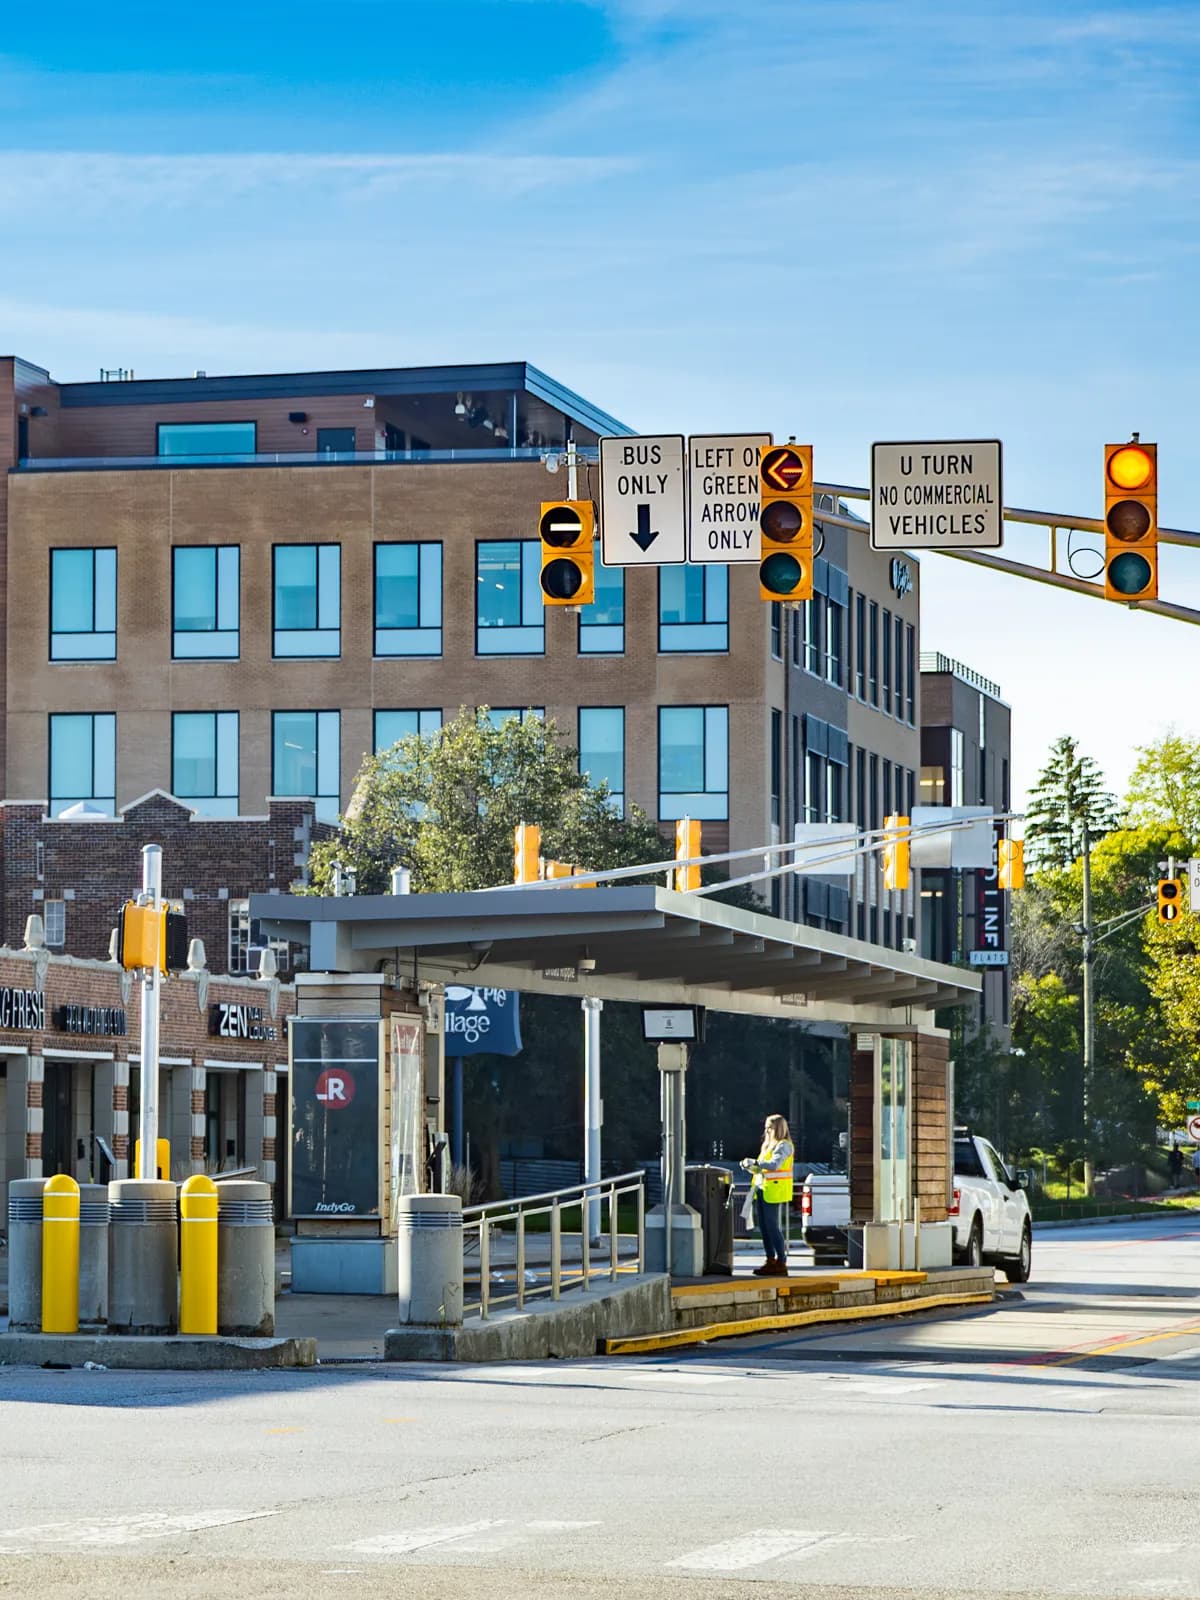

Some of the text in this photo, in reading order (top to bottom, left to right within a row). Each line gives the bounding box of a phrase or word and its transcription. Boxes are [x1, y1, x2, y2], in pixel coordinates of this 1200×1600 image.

[623, 445, 661, 465] BUS
[695, 448, 735, 468] LEFT
[900, 455, 973, 475] U TURN
[618, 474, 668, 495] ONLY
[703, 475, 759, 495] GREEN
[880, 484, 994, 505] NO COMMERCIAL
[701, 502, 761, 522] ARROW
[889, 514, 985, 535] VEHICLES
[708, 530, 753, 549] ONLY
[12, 988, 46, 1030] FRESH
[219, 1003, 248, 1038] ZEN
[249, 1025, 278, 1041] LOUNGE
[326, 1077, 346, 1101] R
[314, 1202, 356, 1213] IndyGo
